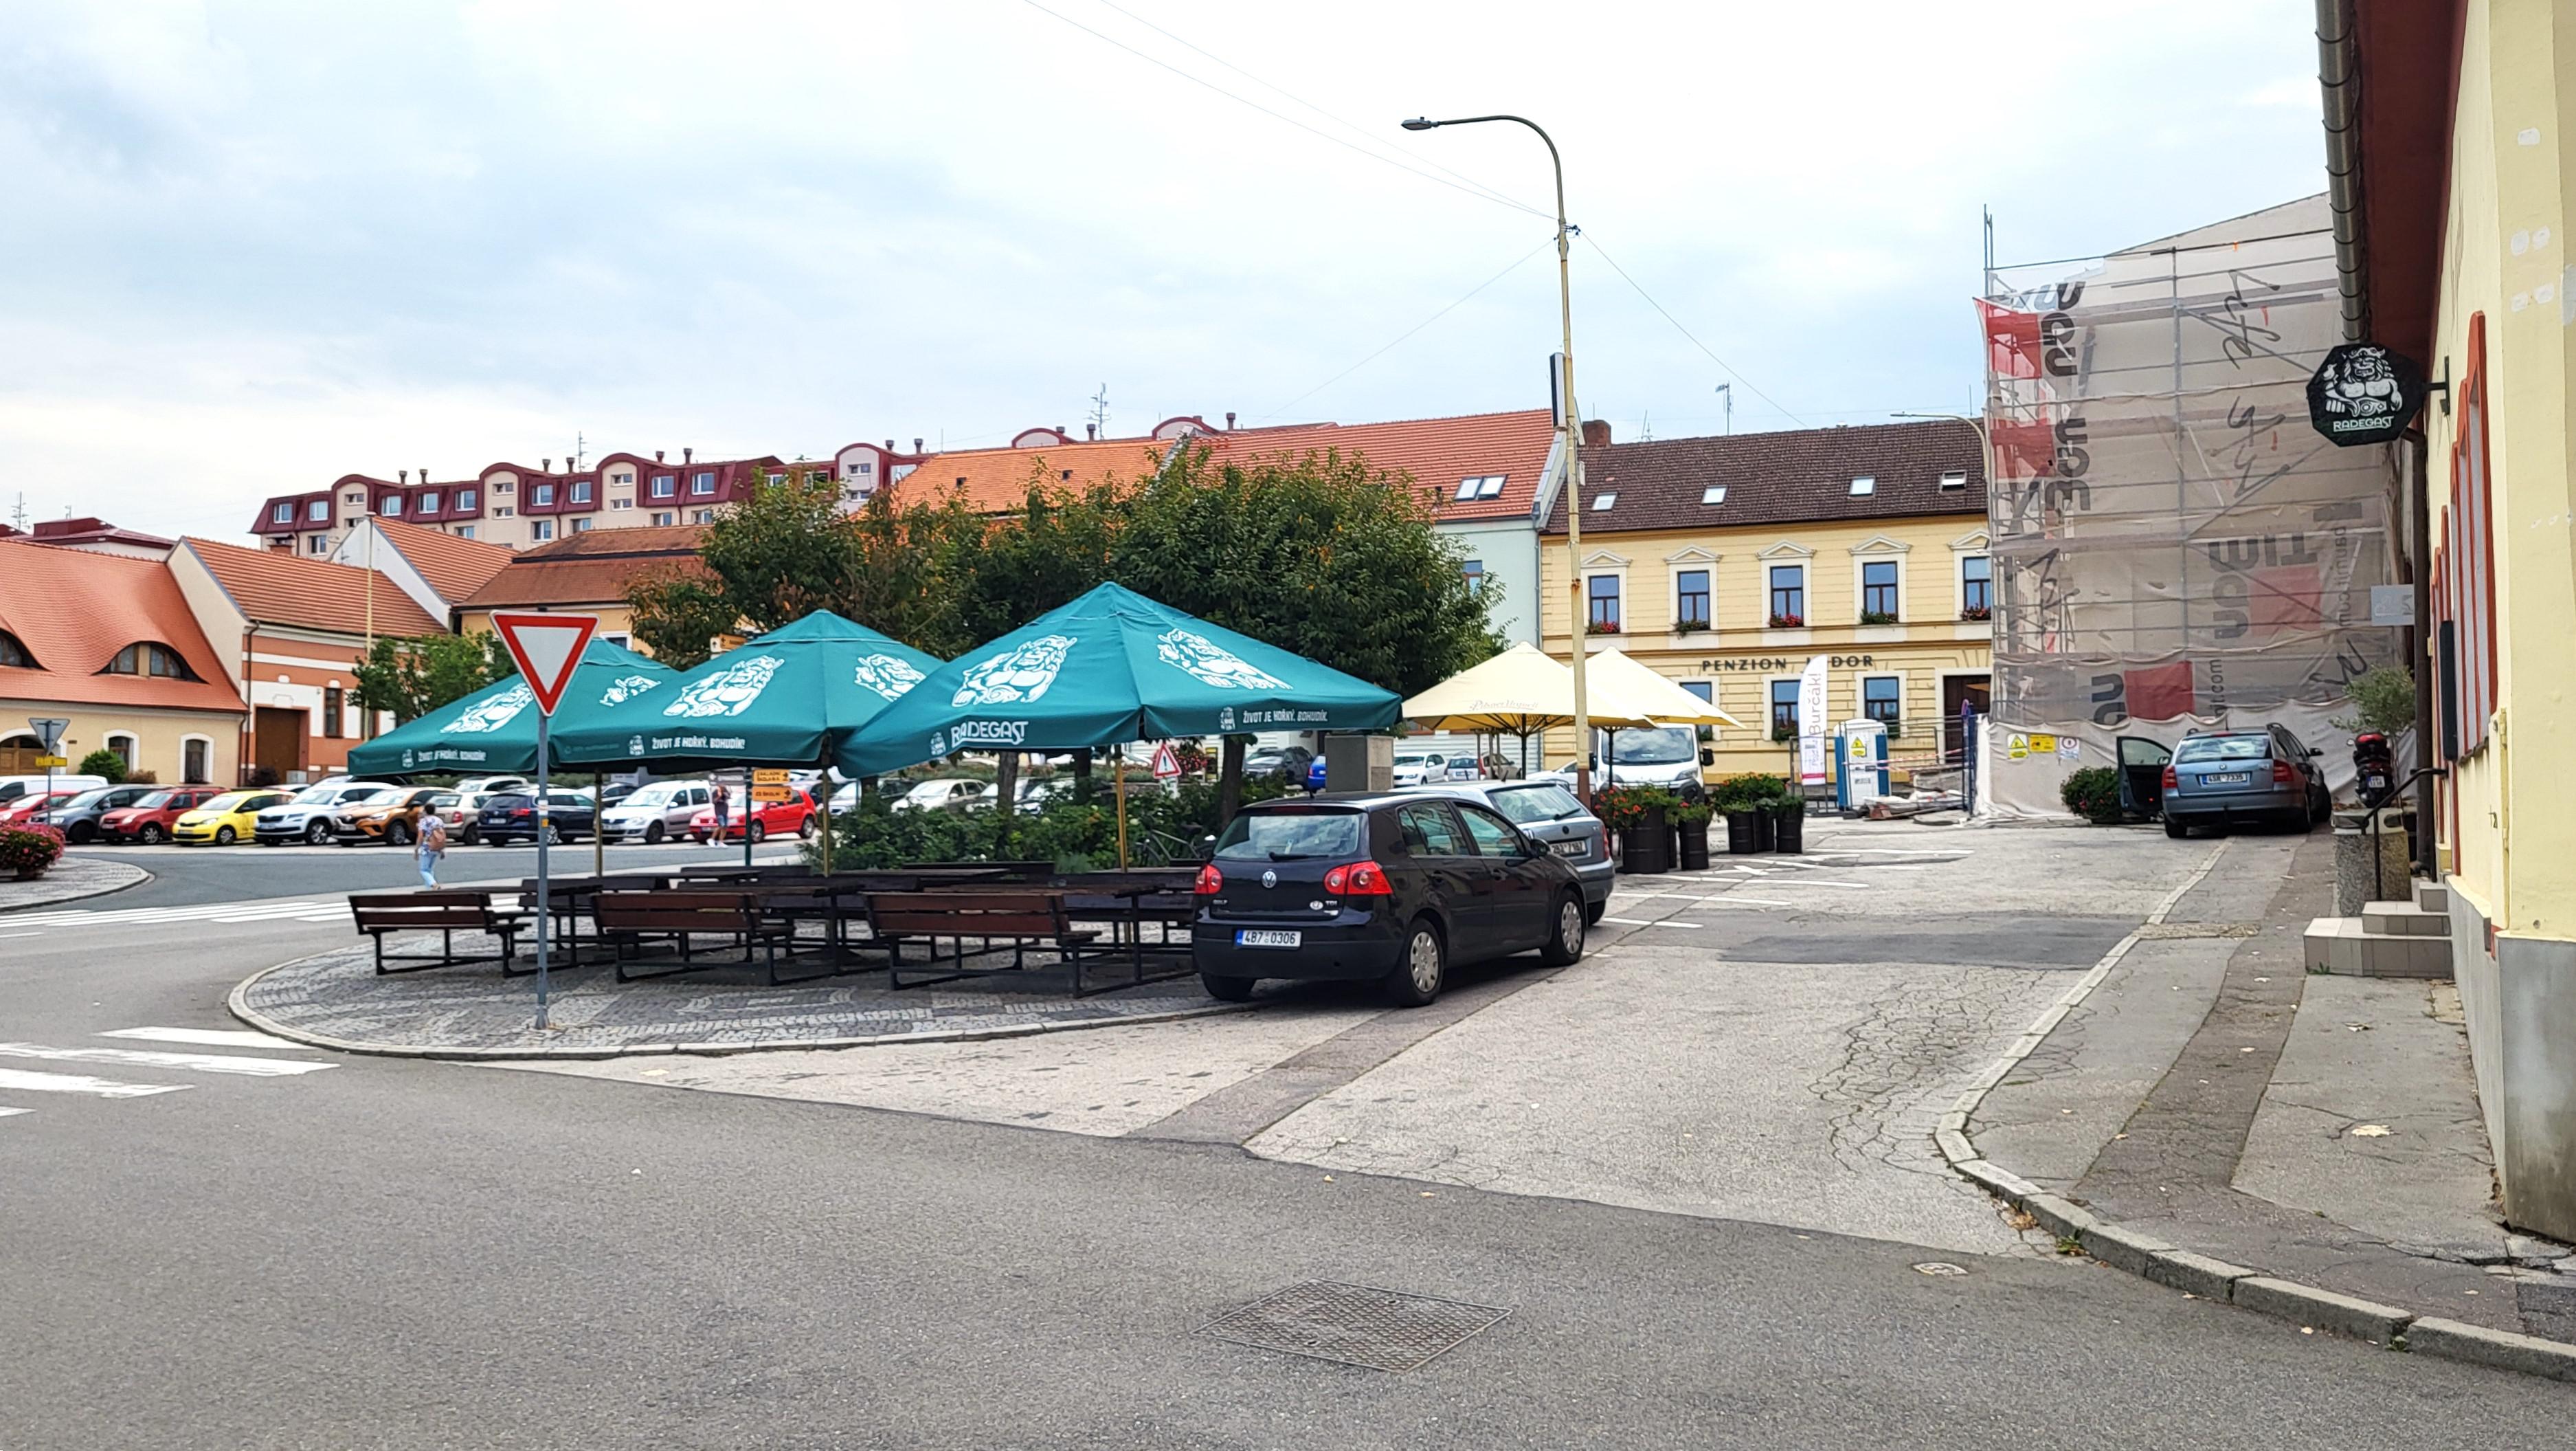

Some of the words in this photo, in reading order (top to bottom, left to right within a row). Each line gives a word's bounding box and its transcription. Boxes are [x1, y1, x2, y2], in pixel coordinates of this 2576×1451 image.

[2333, 415, 2394, 432] RADEGAST
[1702, 658, 1787, 672] PENZION
[1807, 673, 1822, 736] Burčák!
[1242, 710, 1263, 723] ŽIVOT
[1264, 711, 1272, 722] JE
[951, 721, 1029, 749] RADEGAST
[1244, 931, 1264, 944] 4B7
[1270, 931, 1297, 944] 0306
